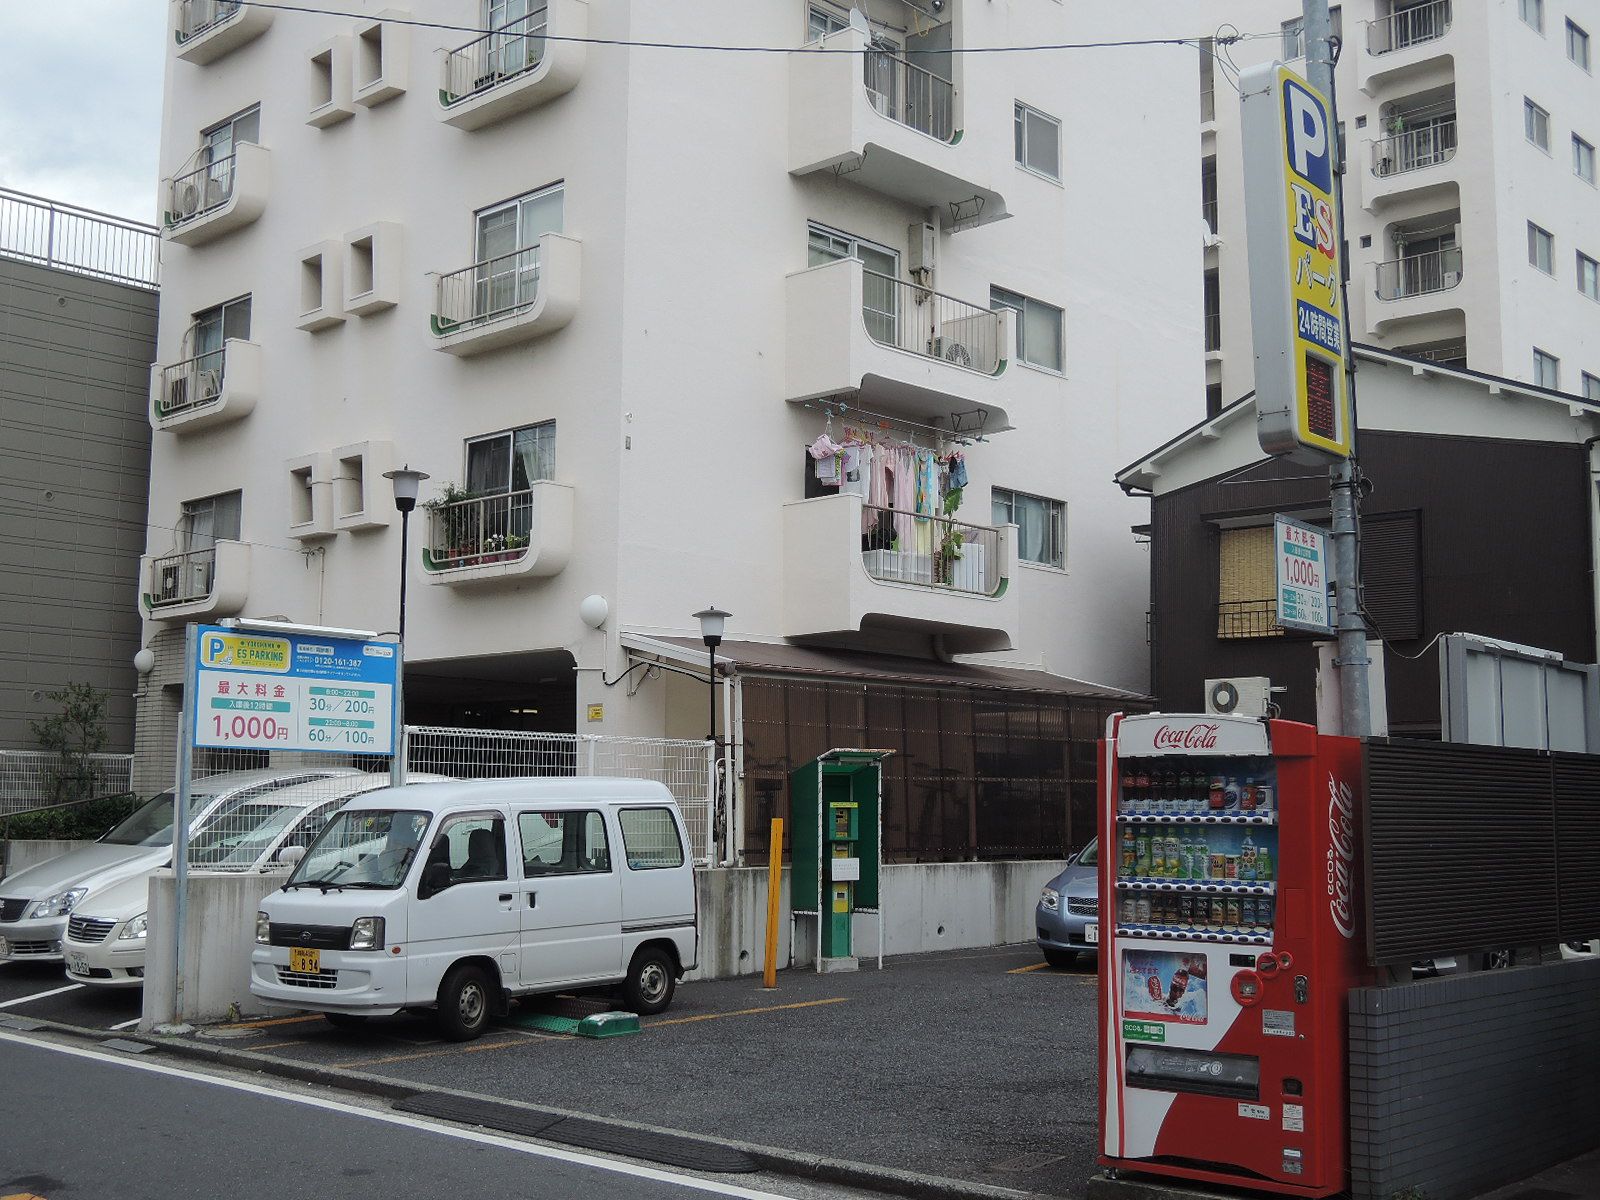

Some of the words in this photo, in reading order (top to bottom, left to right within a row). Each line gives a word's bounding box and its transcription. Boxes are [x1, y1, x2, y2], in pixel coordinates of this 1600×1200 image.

[1290, 85, 1326, 177] P
[1291, 182, 1335, 259] ES
[1295, 250, 1337, 308] パーク
[1299, 306, 1341, 350] 24時間営業
[1285, 556, 1320, 588] 1,000円
[209, 638, 225, 662] P
[237, 649, 248, 659] ES
[249, 650, 284, 662] PARKING
[314, 656, 362, 668] 0120-161-387
[217, 681, 286, 698] 最大料金
[213, 715, 289, 741] 1,000円
[1153, 724, 1221, 750] Coca-Cola
[1328, 770, 1356, 939] Coca-Cola
